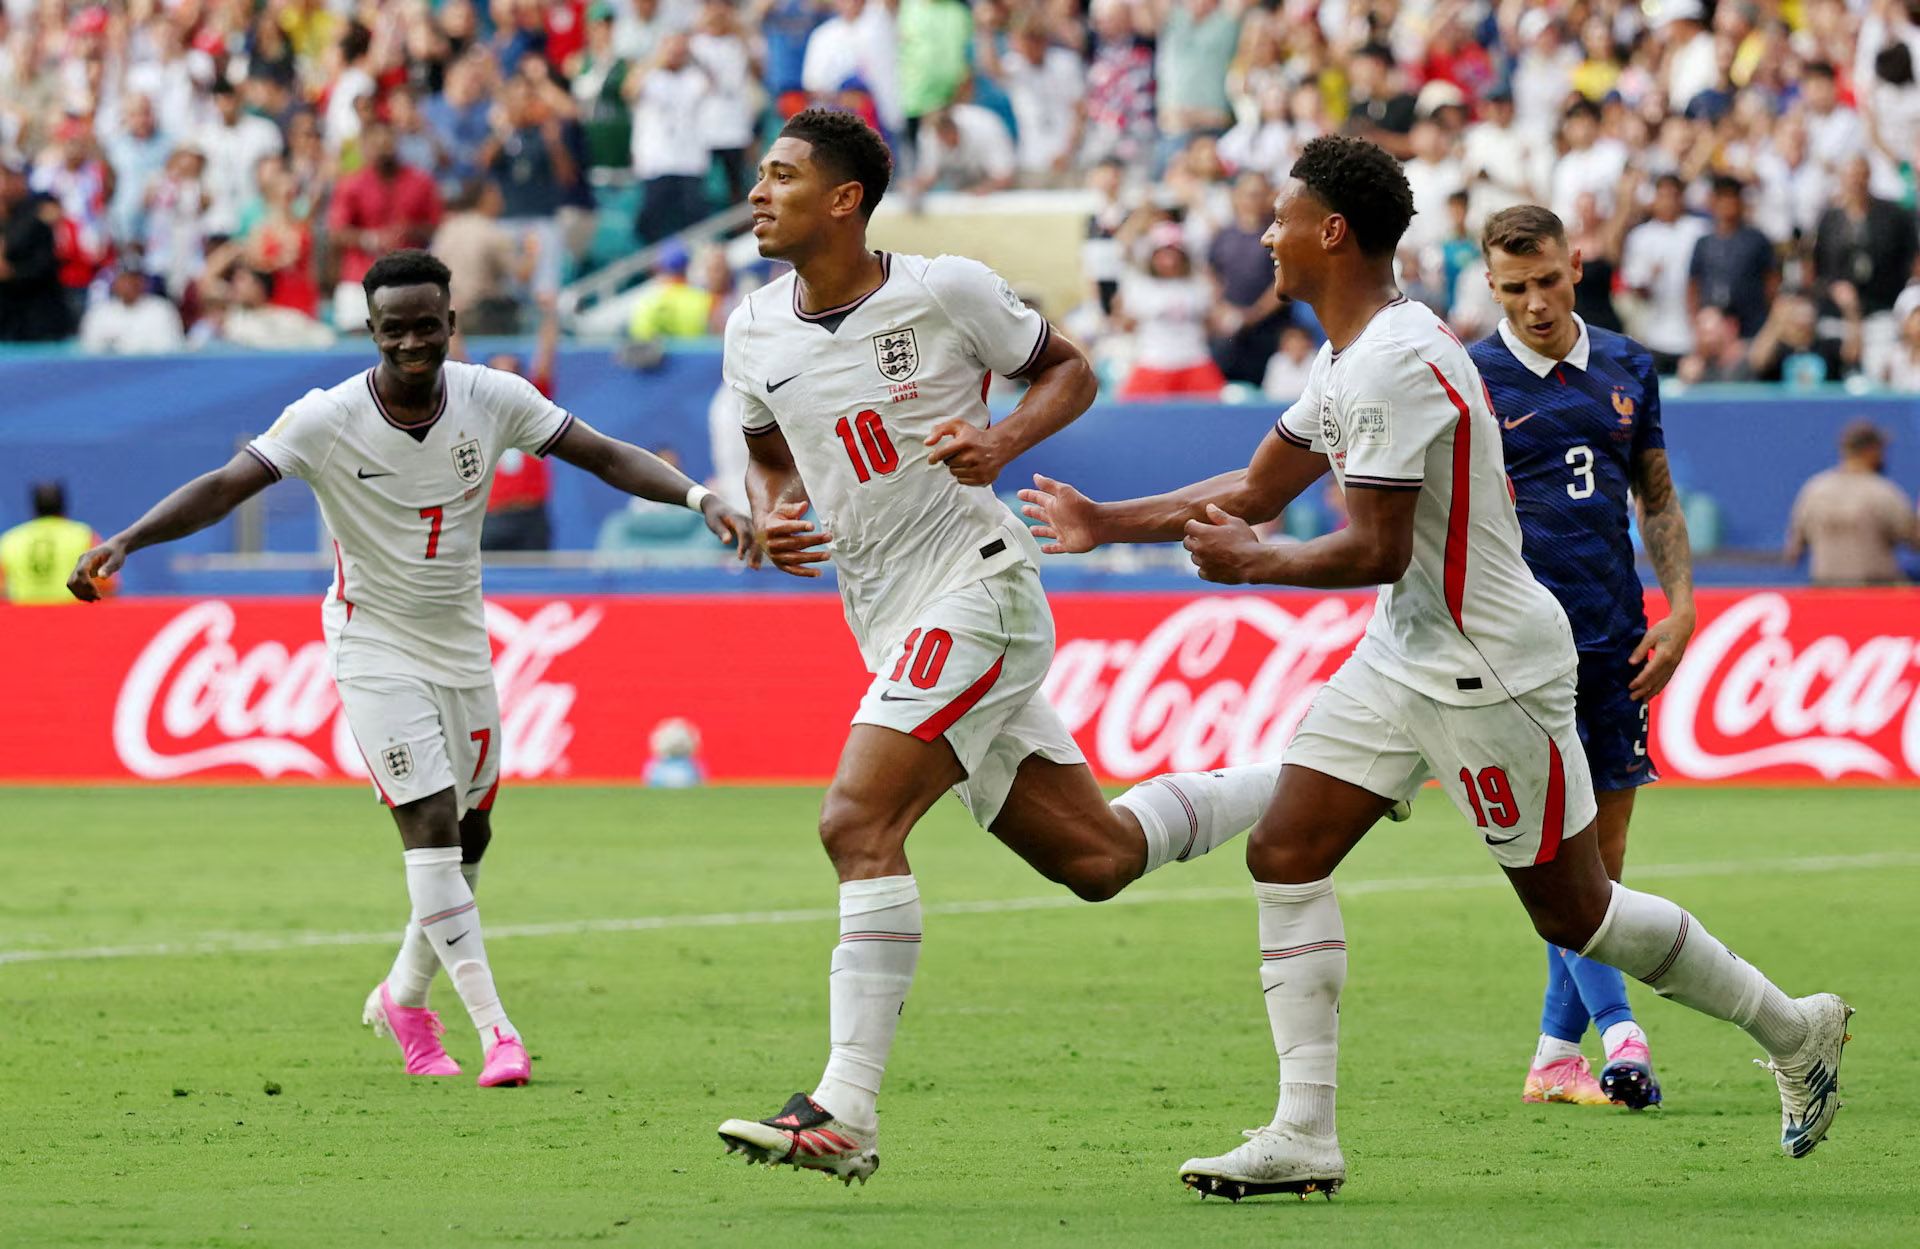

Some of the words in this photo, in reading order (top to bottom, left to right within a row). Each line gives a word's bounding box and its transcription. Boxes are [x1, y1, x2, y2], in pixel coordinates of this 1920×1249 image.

[888, 381, 918, 394] FRANCE
[835, 409, 900, 484] 10
[1564, 445, 1596, 500] 3
[419, 505, 443, 560] 7
[888, 626, 954, 690] 10
[470, 728, 491, 784] 7
[1459, 765, 1521, 829] 19
